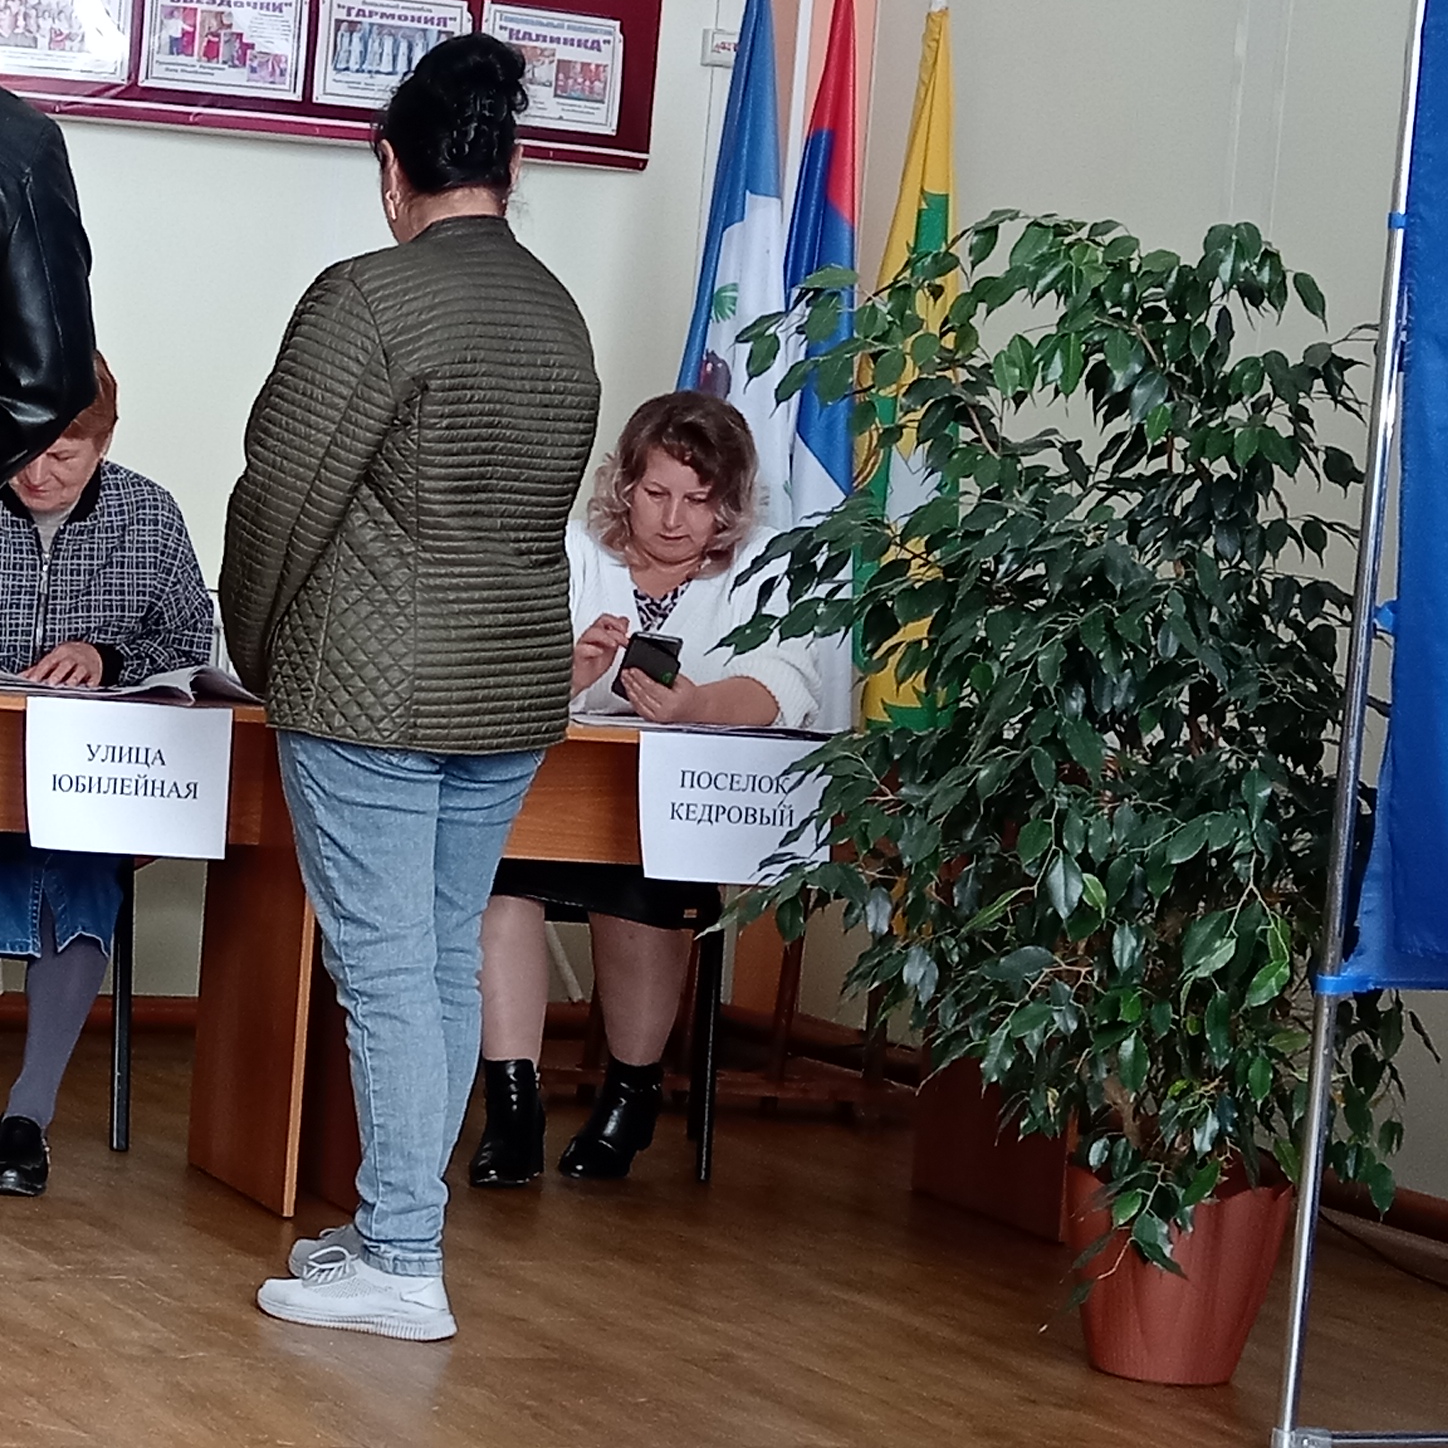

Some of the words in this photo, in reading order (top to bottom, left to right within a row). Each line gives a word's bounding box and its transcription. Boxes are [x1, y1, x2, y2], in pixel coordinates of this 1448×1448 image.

[86, 743, 166, 769] УЛИЦА
[52, 773, 199, 800] ЮБИЛЕЙНАЯ
[679, 769, 790, 795] ПОСЕЛОК
[670, 801, 794, 828] КЕДРОВЫЙ
